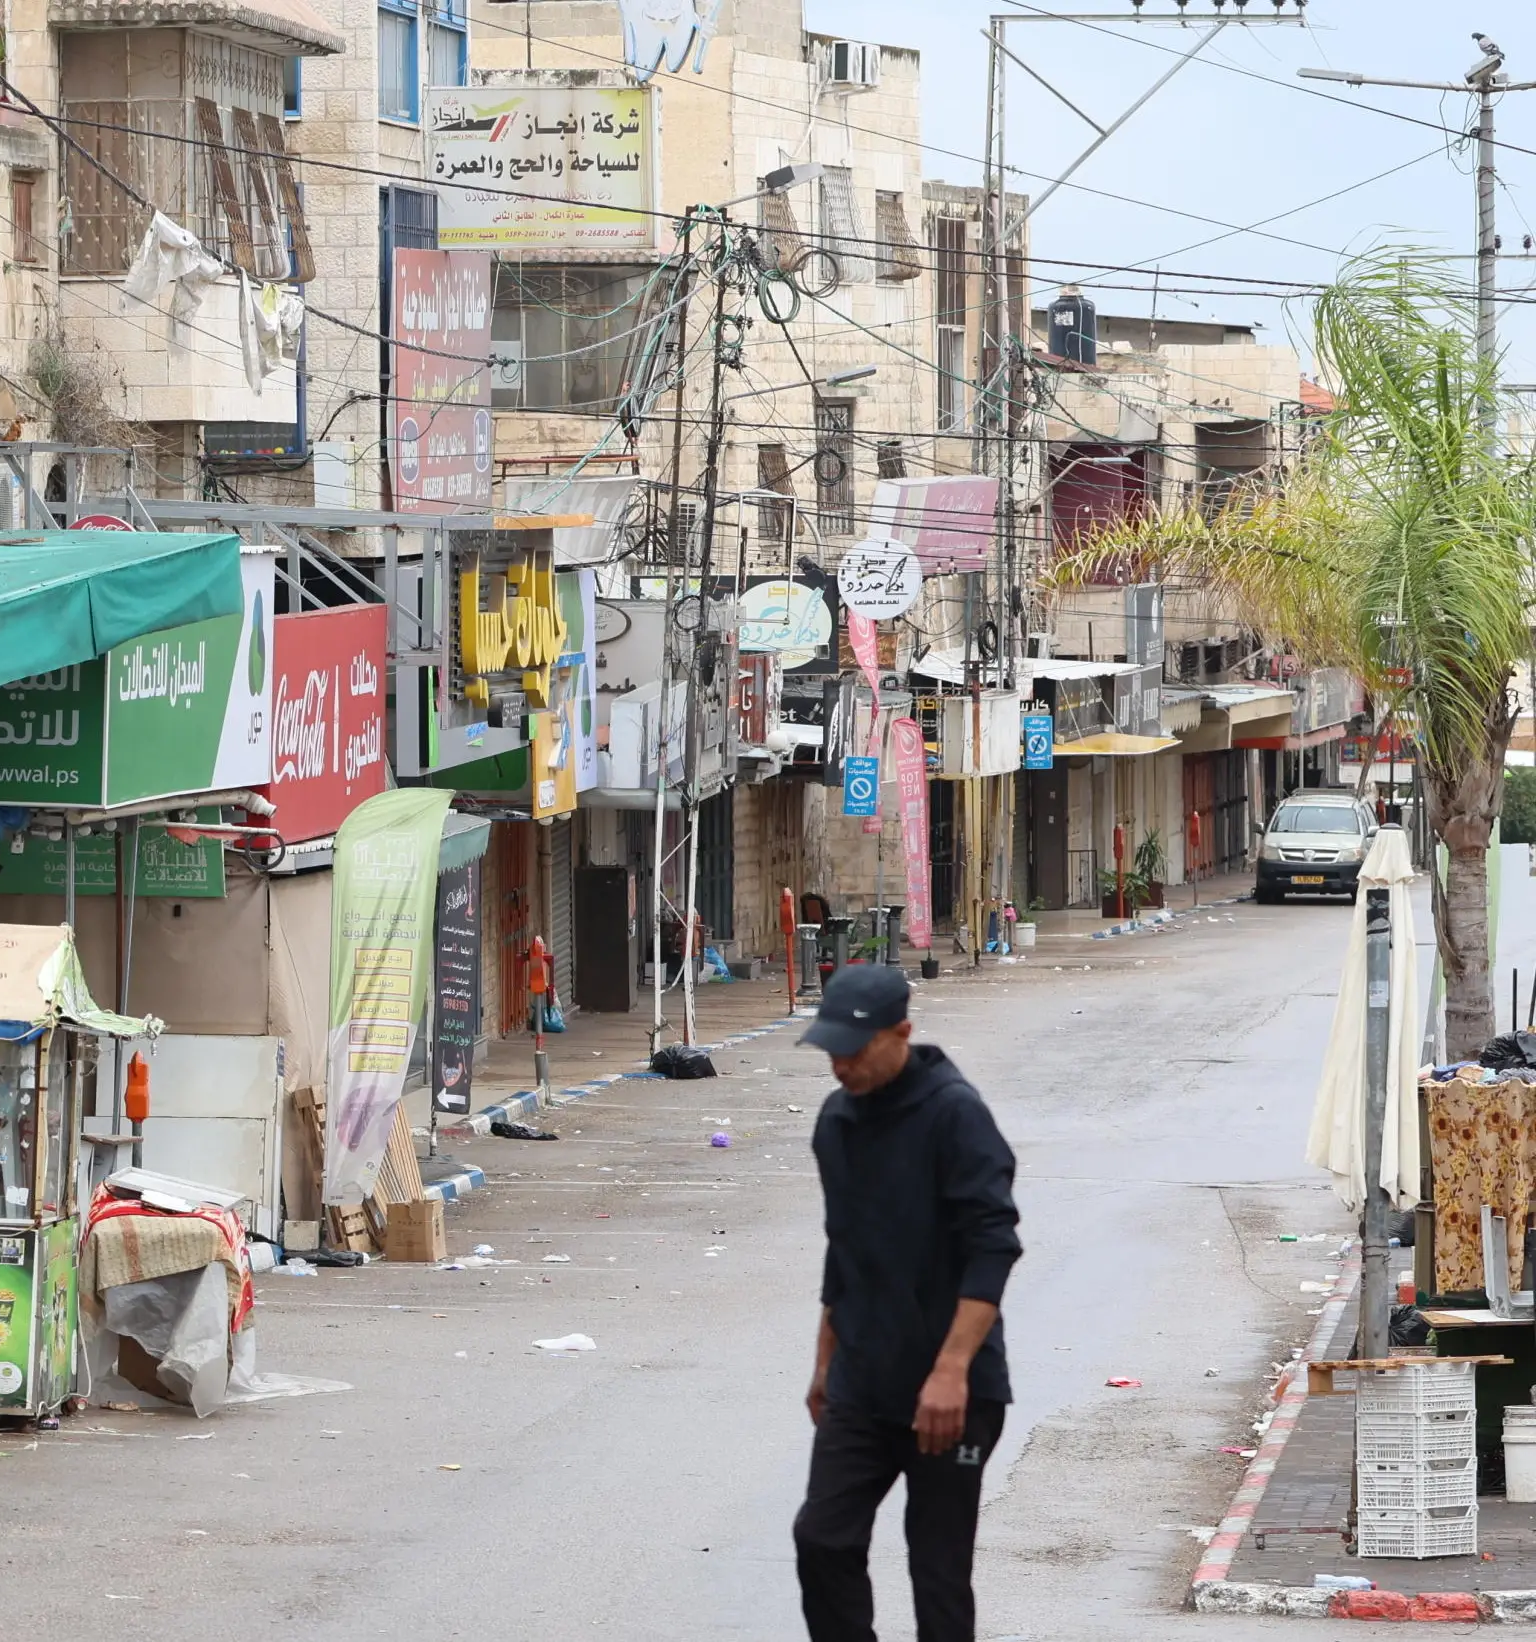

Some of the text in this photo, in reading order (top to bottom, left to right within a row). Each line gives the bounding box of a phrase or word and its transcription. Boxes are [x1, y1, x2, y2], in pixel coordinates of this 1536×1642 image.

[522, 113, 585, 141] إنجاز
[593, 108, 639, 139] شركة
[435, 150, 640, 181] للسياحة والحج والعمرة
[844, 581, 884, 593] حدود
[120, 641, 205, 709] الميدان للاتصالات
[350, 649, 378, 697] محلات
[273, 669, 330, 785] Coca-Cola
[345, 716, 381, 795] الفاخوري
